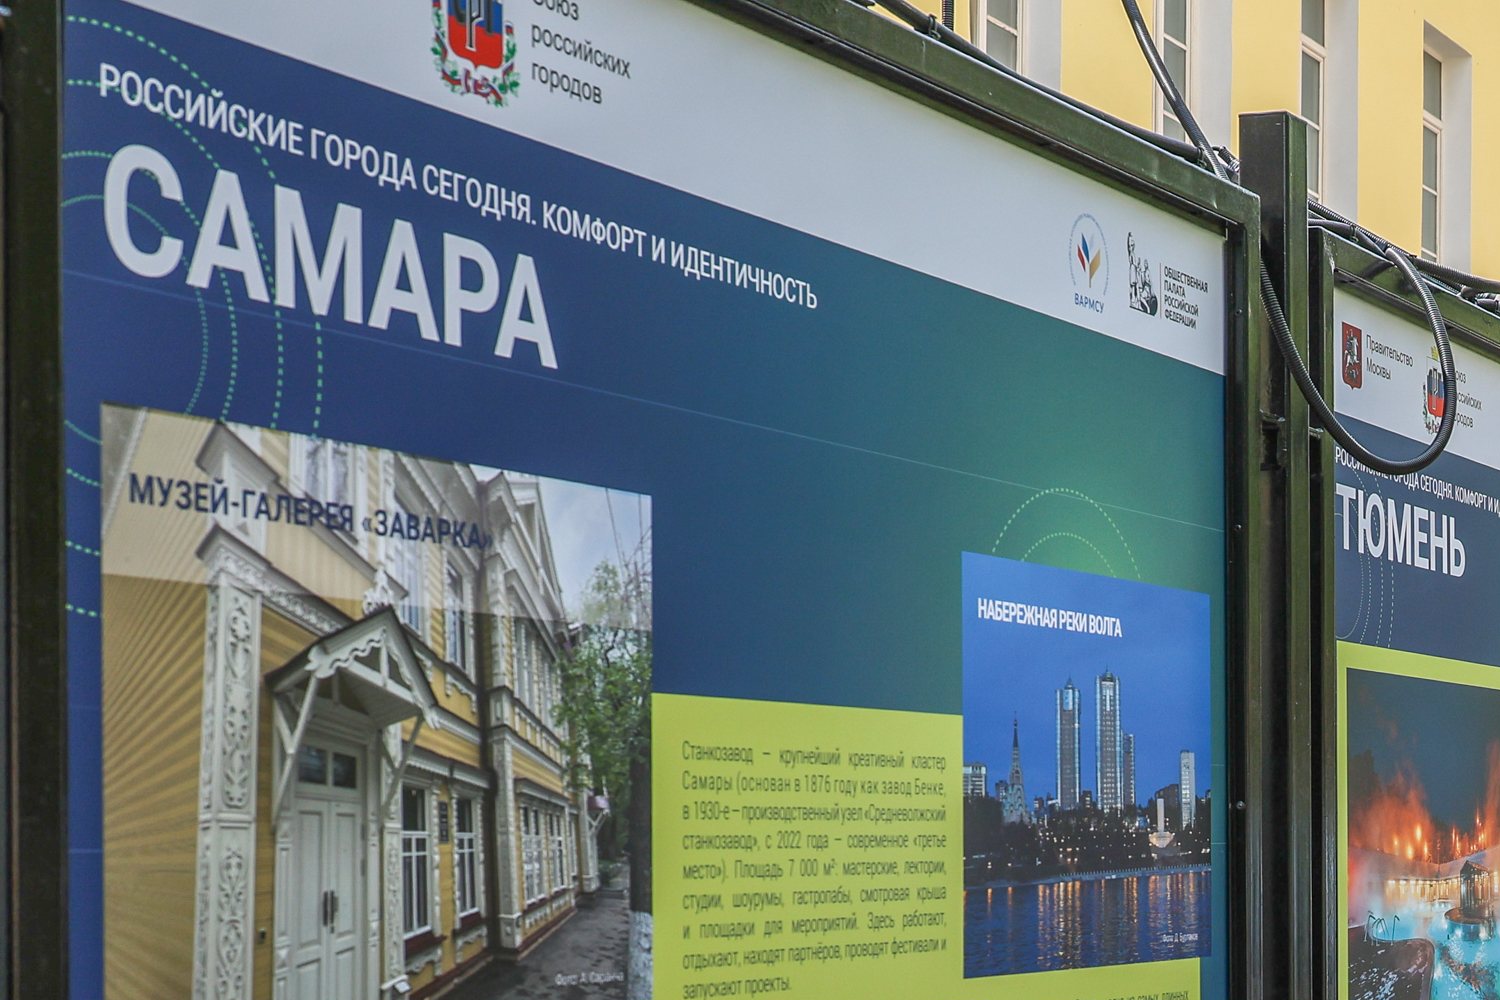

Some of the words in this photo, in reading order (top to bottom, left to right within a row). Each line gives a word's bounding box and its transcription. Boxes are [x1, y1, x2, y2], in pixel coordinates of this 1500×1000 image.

[532, 24, 631, 79] российских
[532, 62, 602, 104] городов
[96, 62, 305, 156] РОССИЙСКИЕ
[310, 128, 417, 190] ГОРОДА
[422, 164, 537, 226] СЕГОДНЯ.
[542, 200, 648, 258] КОМФОРТ
[651, 234, 666, 264] И
[670, 240, 818, 309] ИДЕНТИЧНОСТЬ
[104, 144, 558, 369] САМАРА
[1163, 266, 1208, 293] ОБЩЕСТВЕННАЯ
[1163, 280, 1186, 298] ПАЛАТА
[1074, 292, 1105, 314] ВАРМСУ
[1164, 294, 1199, 317] РОССИЙСКОЙ
[1164, 309, 1197, 329] ФЕДЕРАЦИИ
[1366, 334, 1414, 367] Правительство
[1366, 357, 1391, 381] Москвы
[1455, 370, 1467, 384] оюз
[1420, 474, 1454, 501] СЕГОДНЯ.
[1454, 485, 1487, 511] КОМФОРТ
[1488, 497, 1494, 512] И
[129, 472, 354, 532] МУЗЕЙ-ГАЛЕРЕЯ
[362, 508, 493, 550] «ЗАВАРКА»
[1335, 483, 1466, 578] ТЮМЕНЬ
[978, 597, 1057, 629] НАБЕРЕЖНАЯ
[1059, 611, 1087, 634] РЕКИ
[1089, 615, 1122, 638] ВОЛГА
